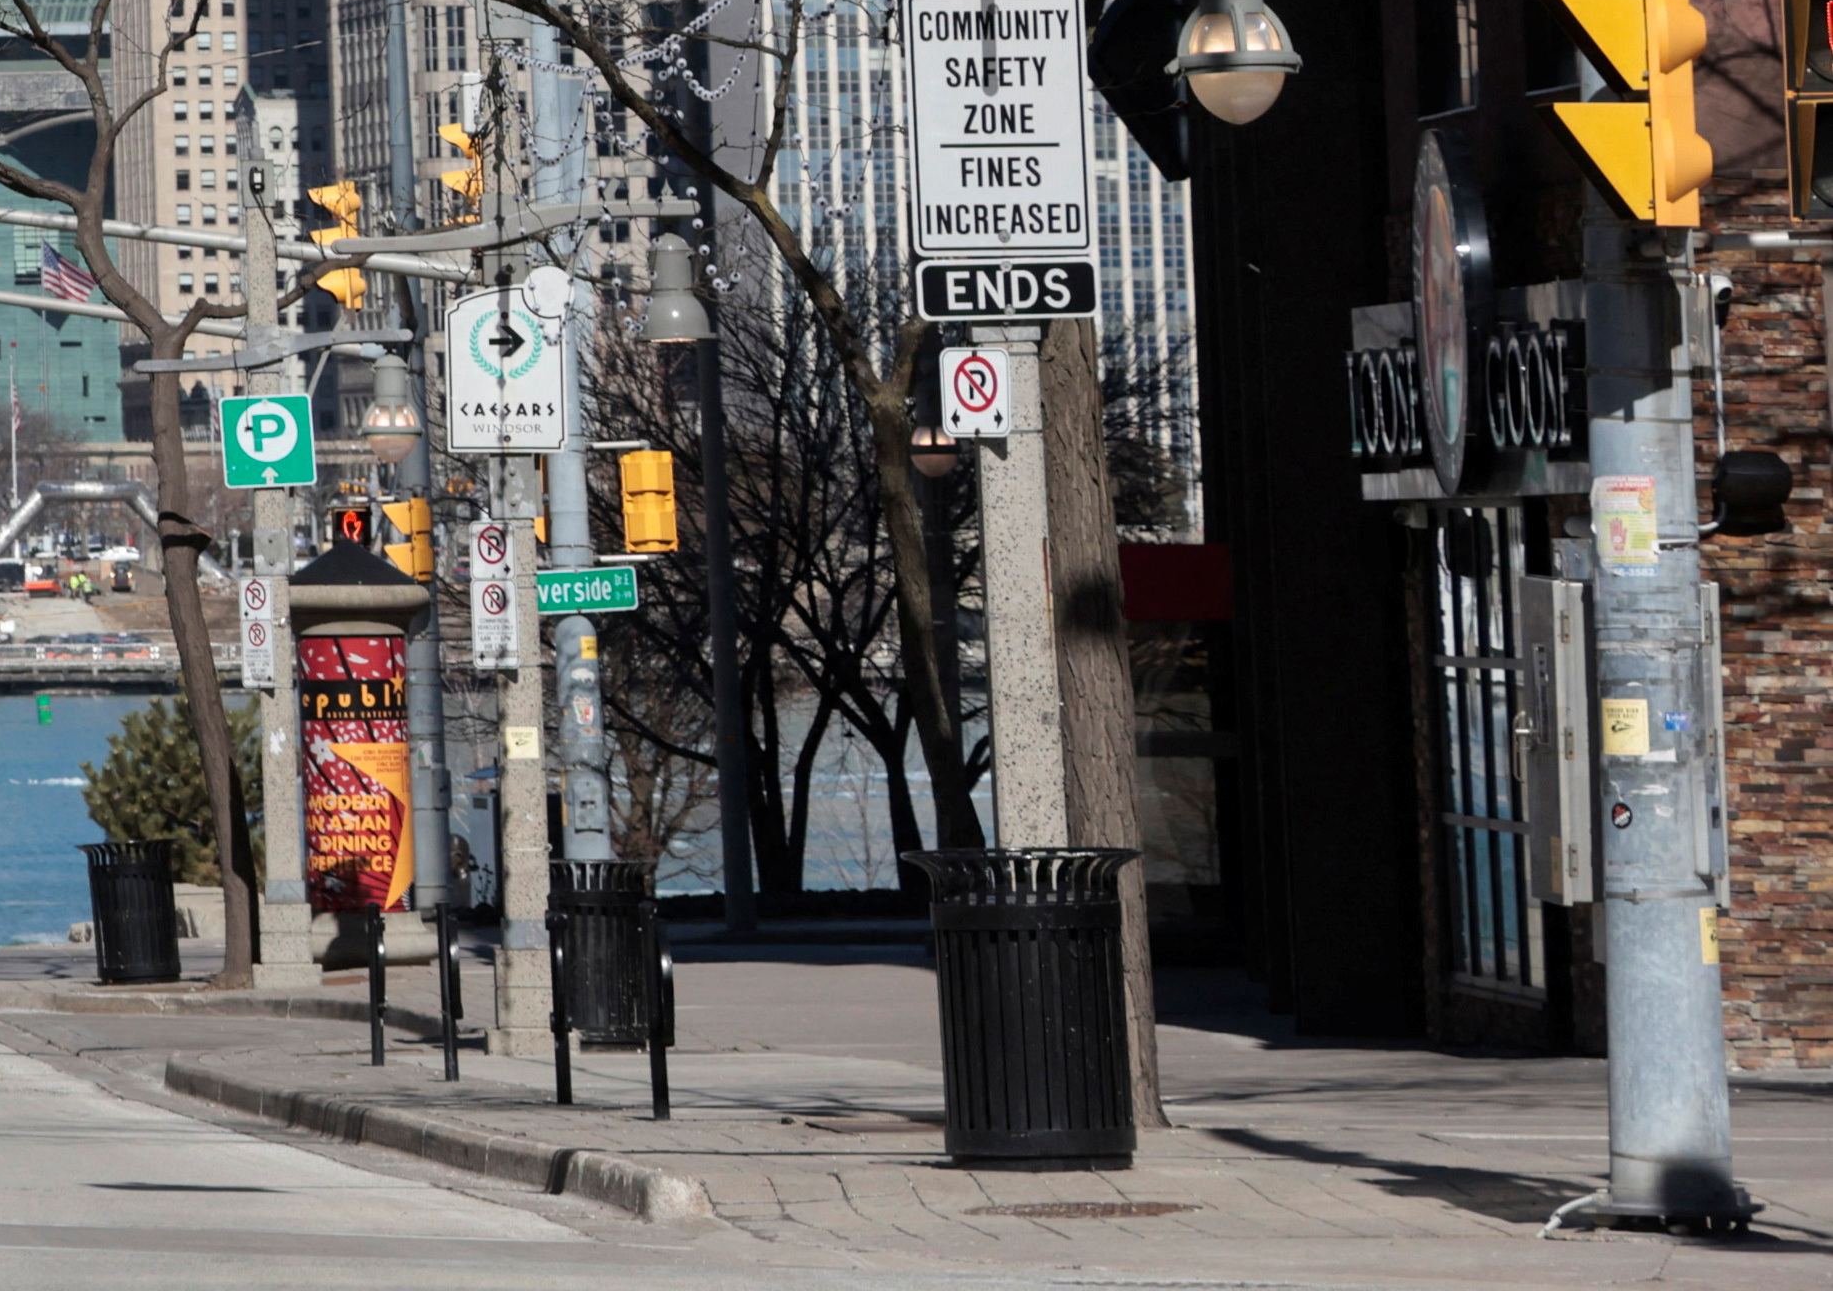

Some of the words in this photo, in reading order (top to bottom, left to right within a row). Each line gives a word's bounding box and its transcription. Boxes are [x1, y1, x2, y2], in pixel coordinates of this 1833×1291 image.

[918, 9, 1070, 42] COMMUNITY
[944, 56, 1048, 88] SAFETY
[962, 103, 1036, 135] ZONE
[959, 156, 1043, 188] FINES
[924, 202, 1082, 236] INCREASED
[944, 267, 1073, 312] ENDS
[459, 402, 556, 417] CAESARS
[251, 413, 287, 453] P
[472, 423, 544, 434] WINDSOR
[537, 576, 613, 604] verside
[308, 794, 391, 810] MODERN
[329, 814, 391, 831] ASIAN
[319, 834, 392, 852] DINING
